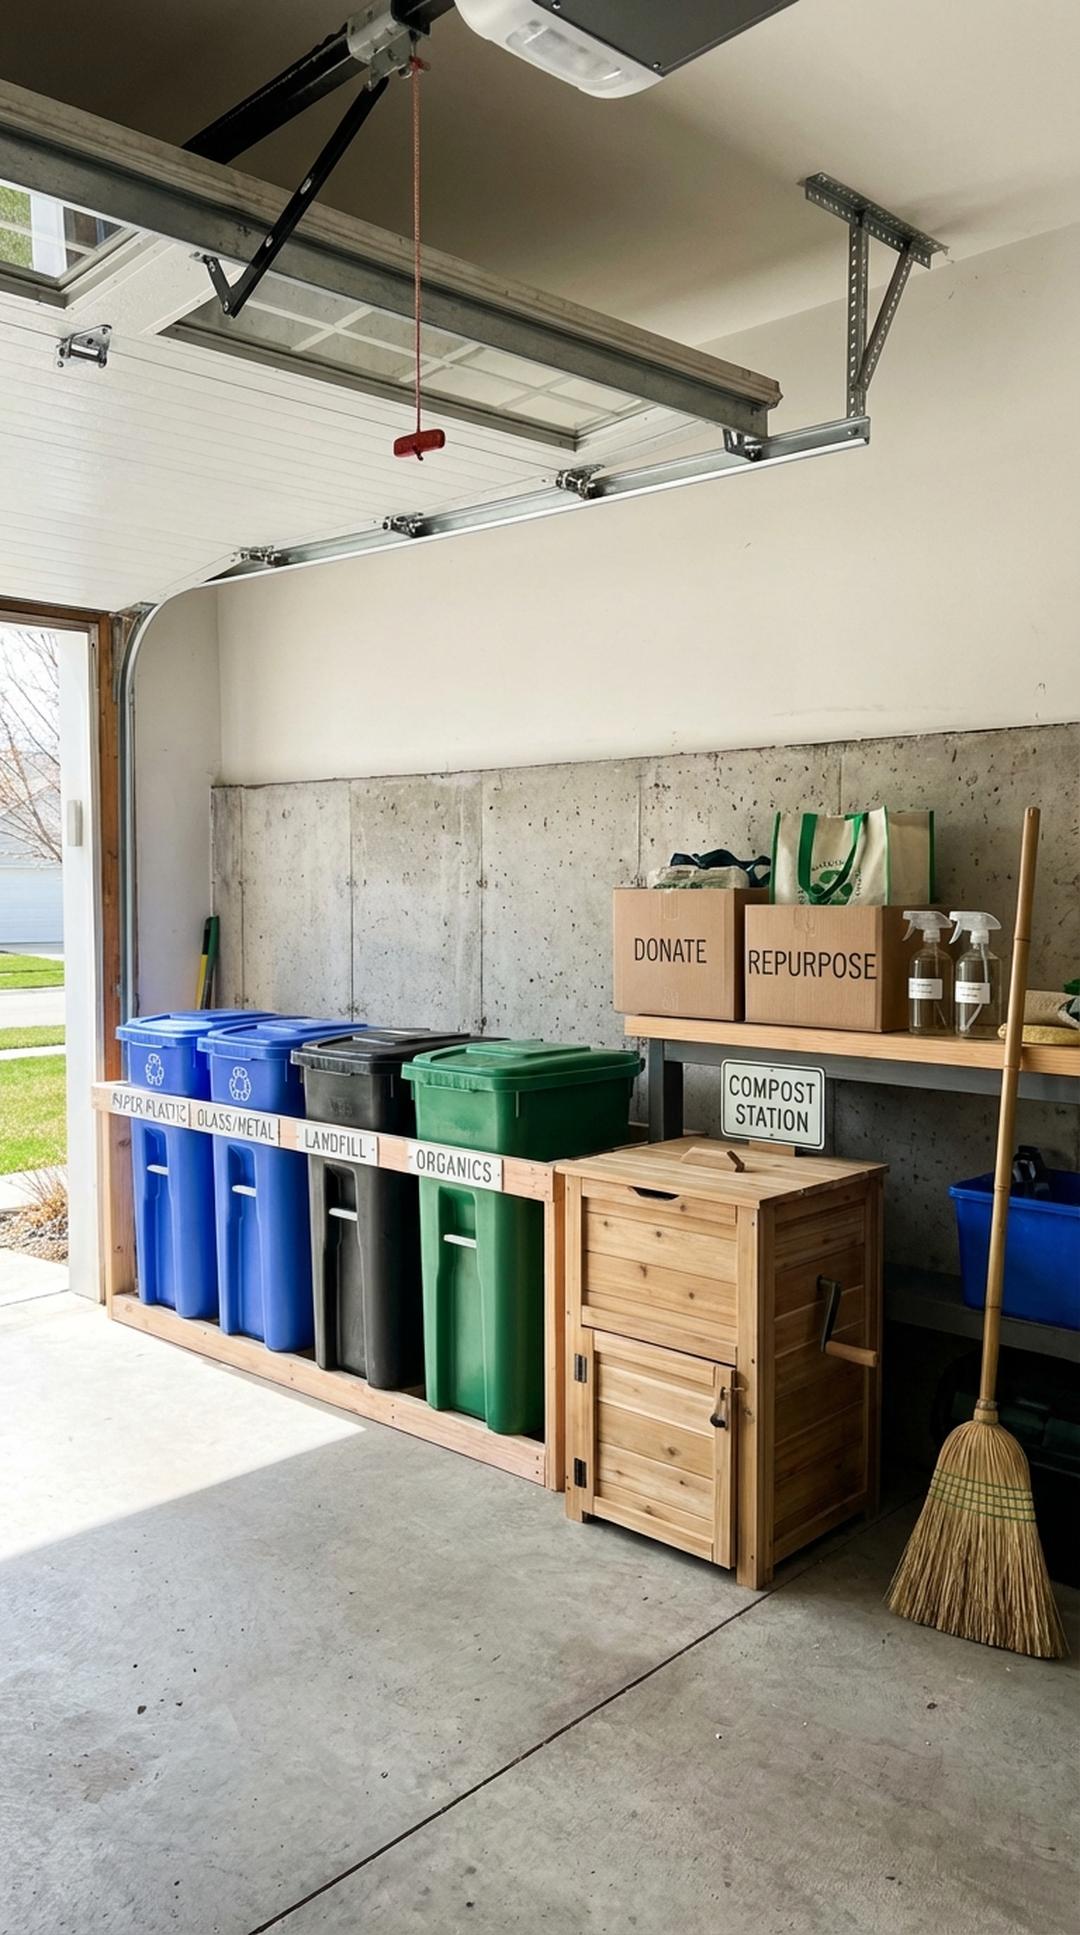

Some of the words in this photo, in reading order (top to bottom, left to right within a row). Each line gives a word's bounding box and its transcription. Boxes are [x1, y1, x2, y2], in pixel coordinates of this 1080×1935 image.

[634, 937, 707, 964] DONATE
[748, 949, 878, 980] REPURPOSE
[729, 1074, 816, 1105] COMPOST
[735, 1103, 808, 1133] STATION
[304, 1128, 367, 1159] LANDFILL
[416, 1148, 492, 1184] ORGANICS
